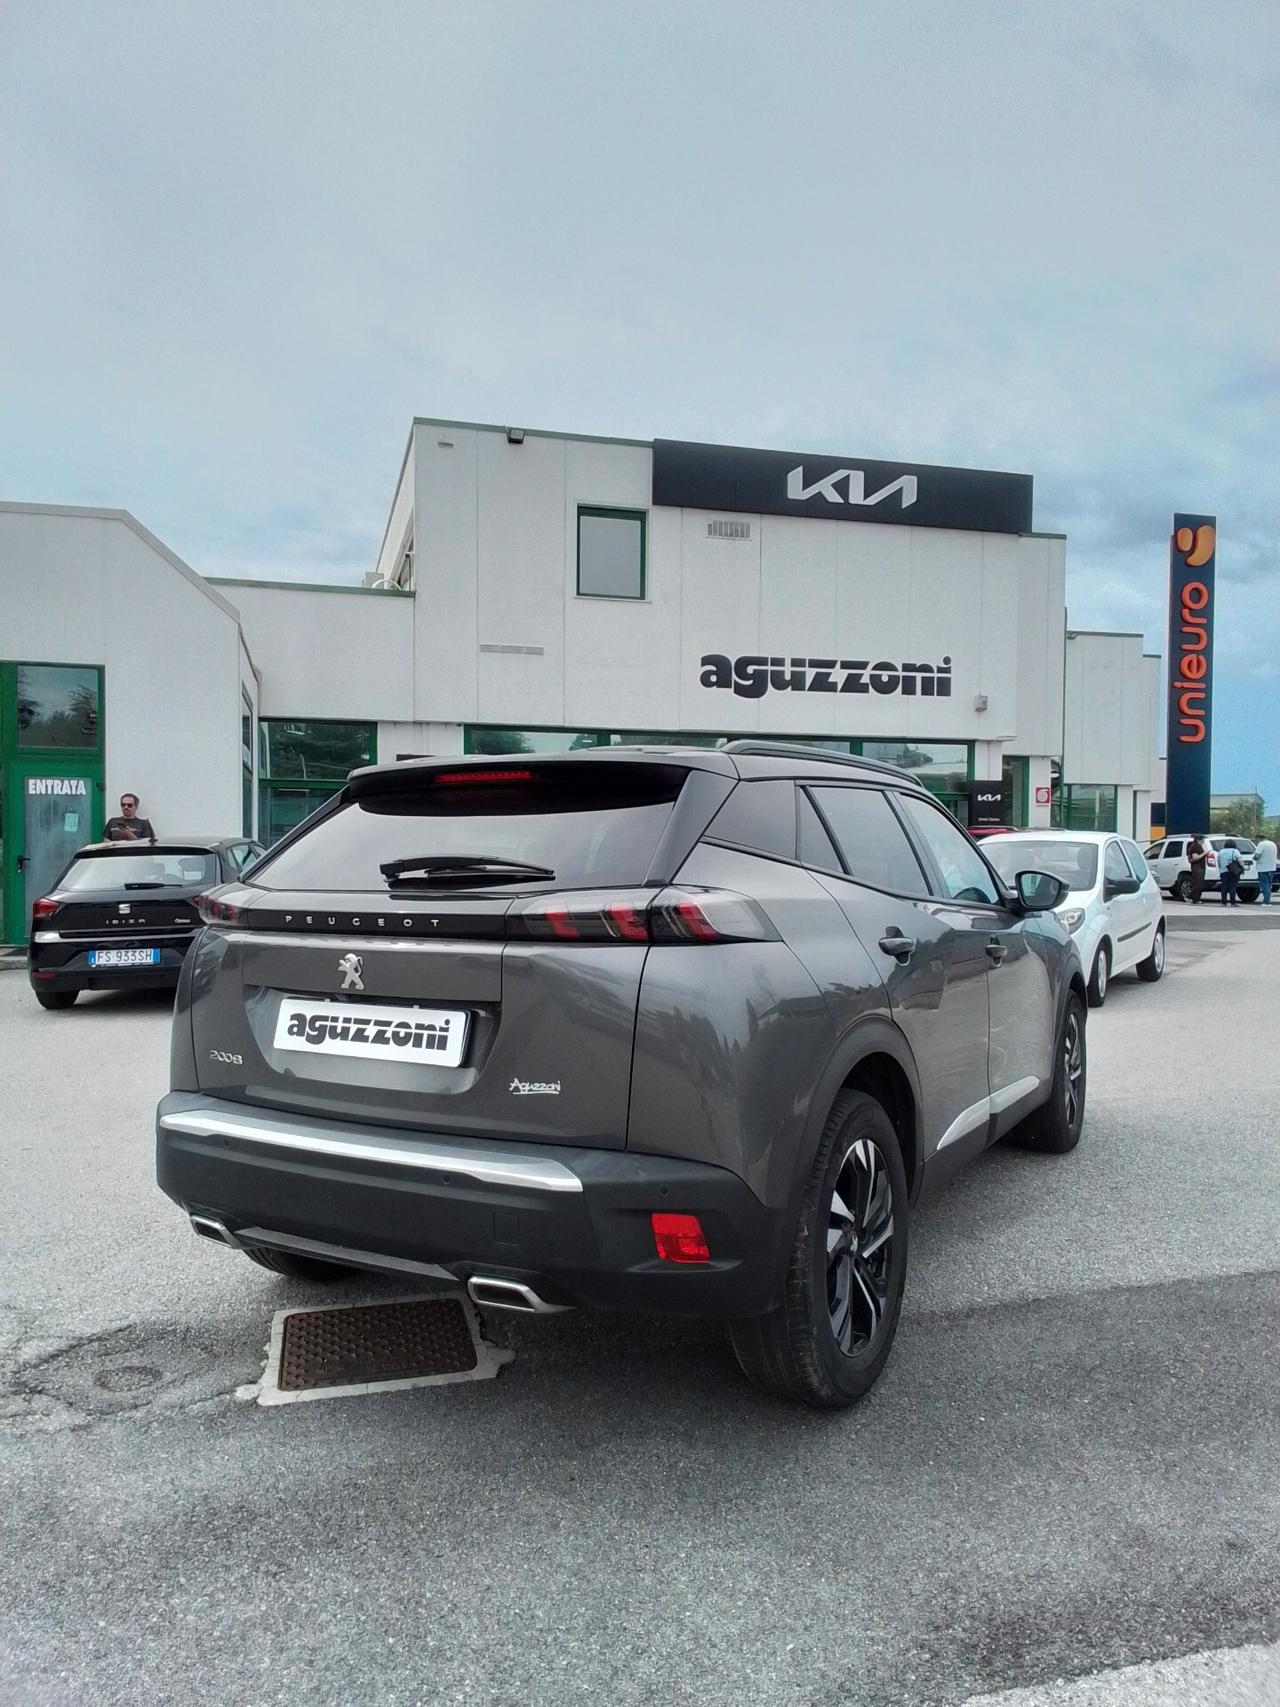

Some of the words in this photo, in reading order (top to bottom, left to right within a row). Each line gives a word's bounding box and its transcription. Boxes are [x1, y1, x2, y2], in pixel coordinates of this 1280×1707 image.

[786, 465, 918, 509] KIA
[1174, 581, 1208, 742] unieuro
[700, 653, 952, 699] aguzzoni
[28, 779, 86, 796] ENTRATA
[977, 793, 1002, 802] KIA
[285, 915, 440, 928] PEUGEOT
[287, 1012, 451, 1051] aguzzoni
[209, 1049, 243, 1065] 2008
[509, 1077, 561, 1094] Aguzzoni
